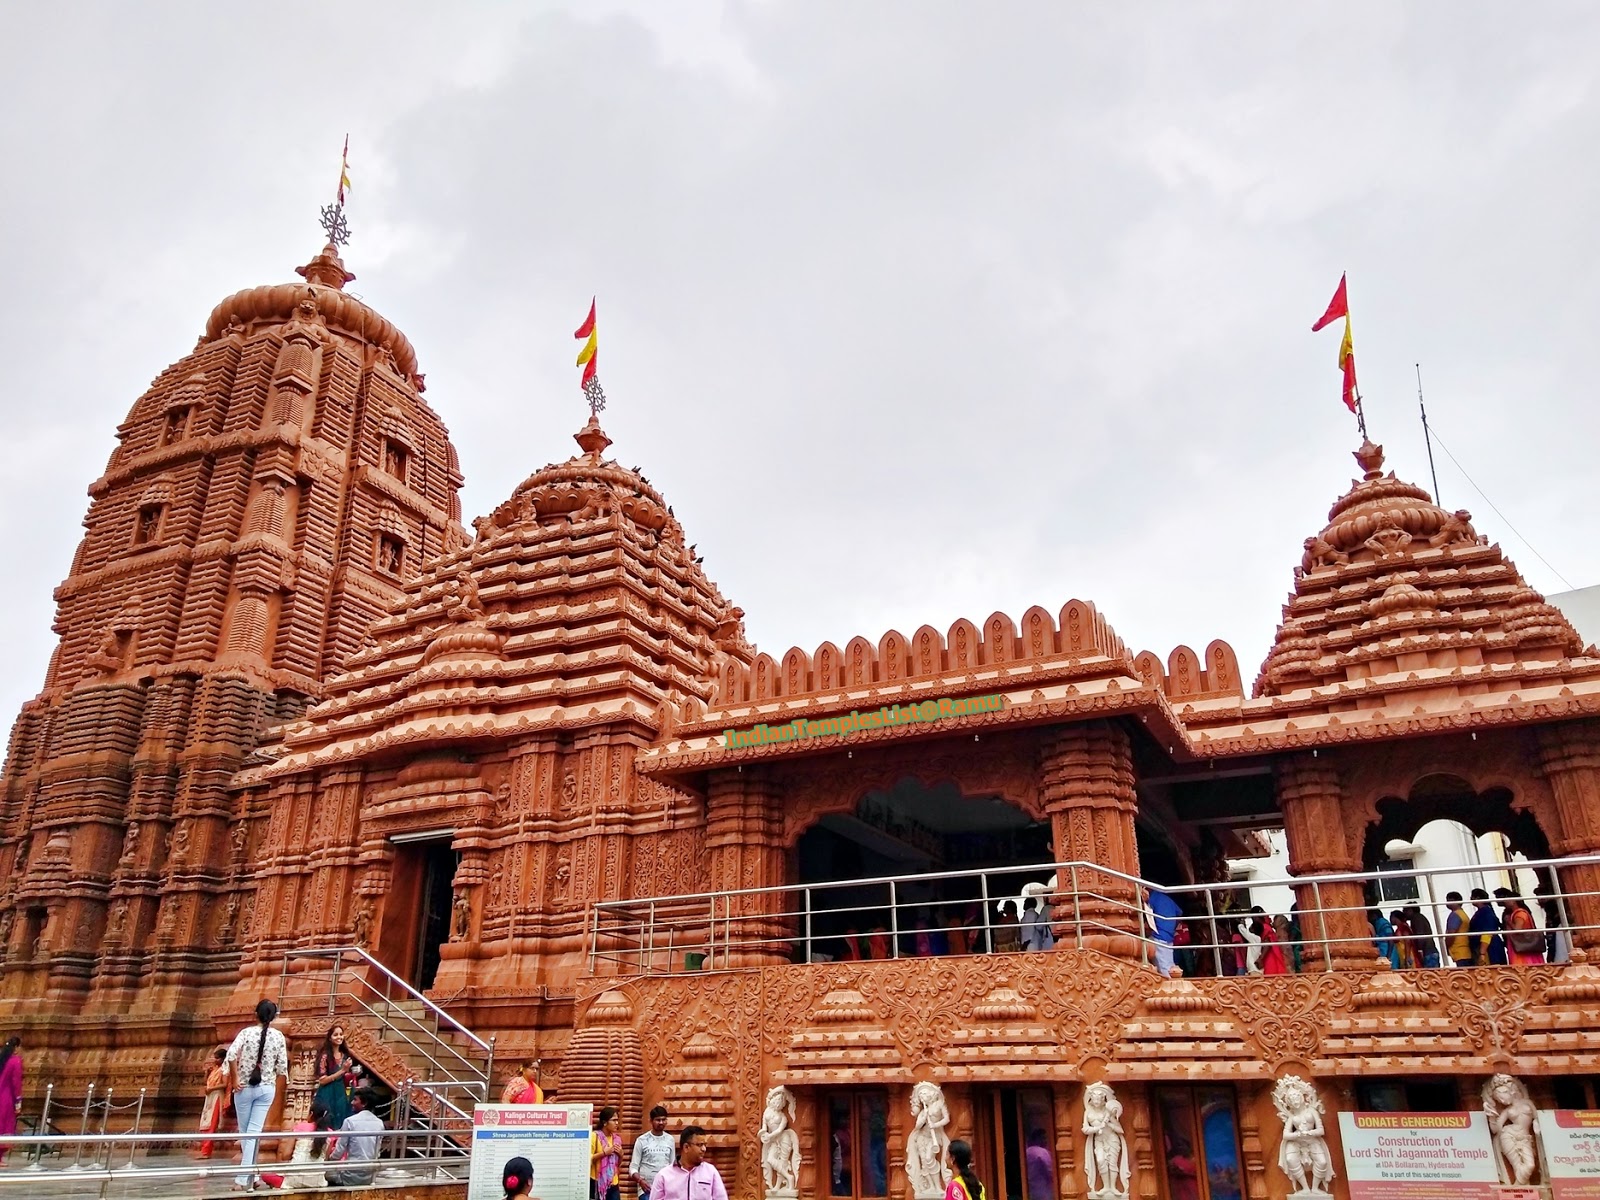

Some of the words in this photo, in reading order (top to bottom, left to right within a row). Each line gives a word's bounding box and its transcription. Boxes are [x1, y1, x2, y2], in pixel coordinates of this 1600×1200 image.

[504, 1112, 526, 1120] Kalinga
[1358, 1117, 1400, 1128] DONATE
[1402, 1116, 1467, 1128] GENEROUSLY
[1378, 1136, 1440, 1147] Construction
[1443, 1136, 1453, 1146] of
[1350, 1148, 1371, 1158] Lord
[1374, 1148, 1394, 1158] Shri
[1396, 1148, 1448, 1160] Jagannath
[1452, 1148, 1488, 1160] Temple
[1395, 1161, 1427, 1169] Bollaram,
[1428, 1161, 1464, 1170] Hyderabad
